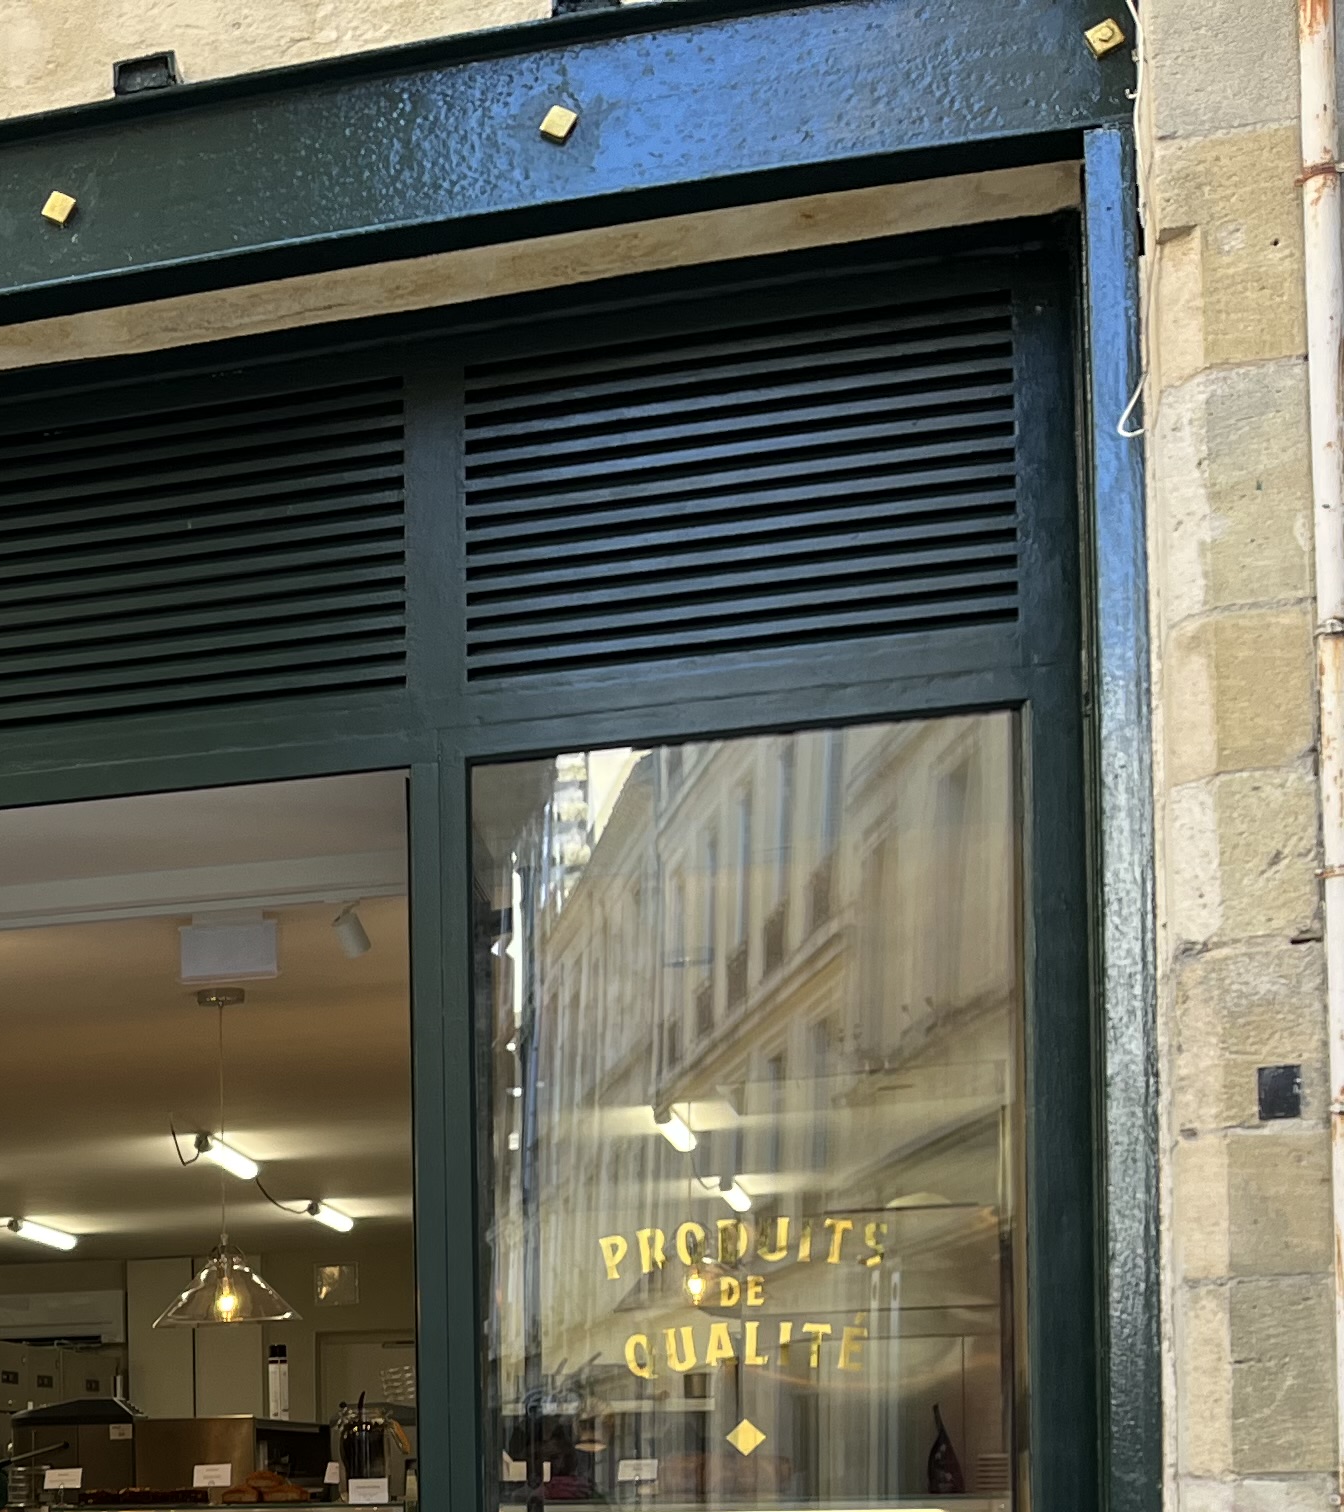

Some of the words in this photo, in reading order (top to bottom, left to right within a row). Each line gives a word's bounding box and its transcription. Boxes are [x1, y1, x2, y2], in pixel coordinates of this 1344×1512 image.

[599, 1216, 888, 1280] PRODUITS
[720, 1276, 765, 1307] DE
[624, 1312, 868, 1379] QUALITÉ
